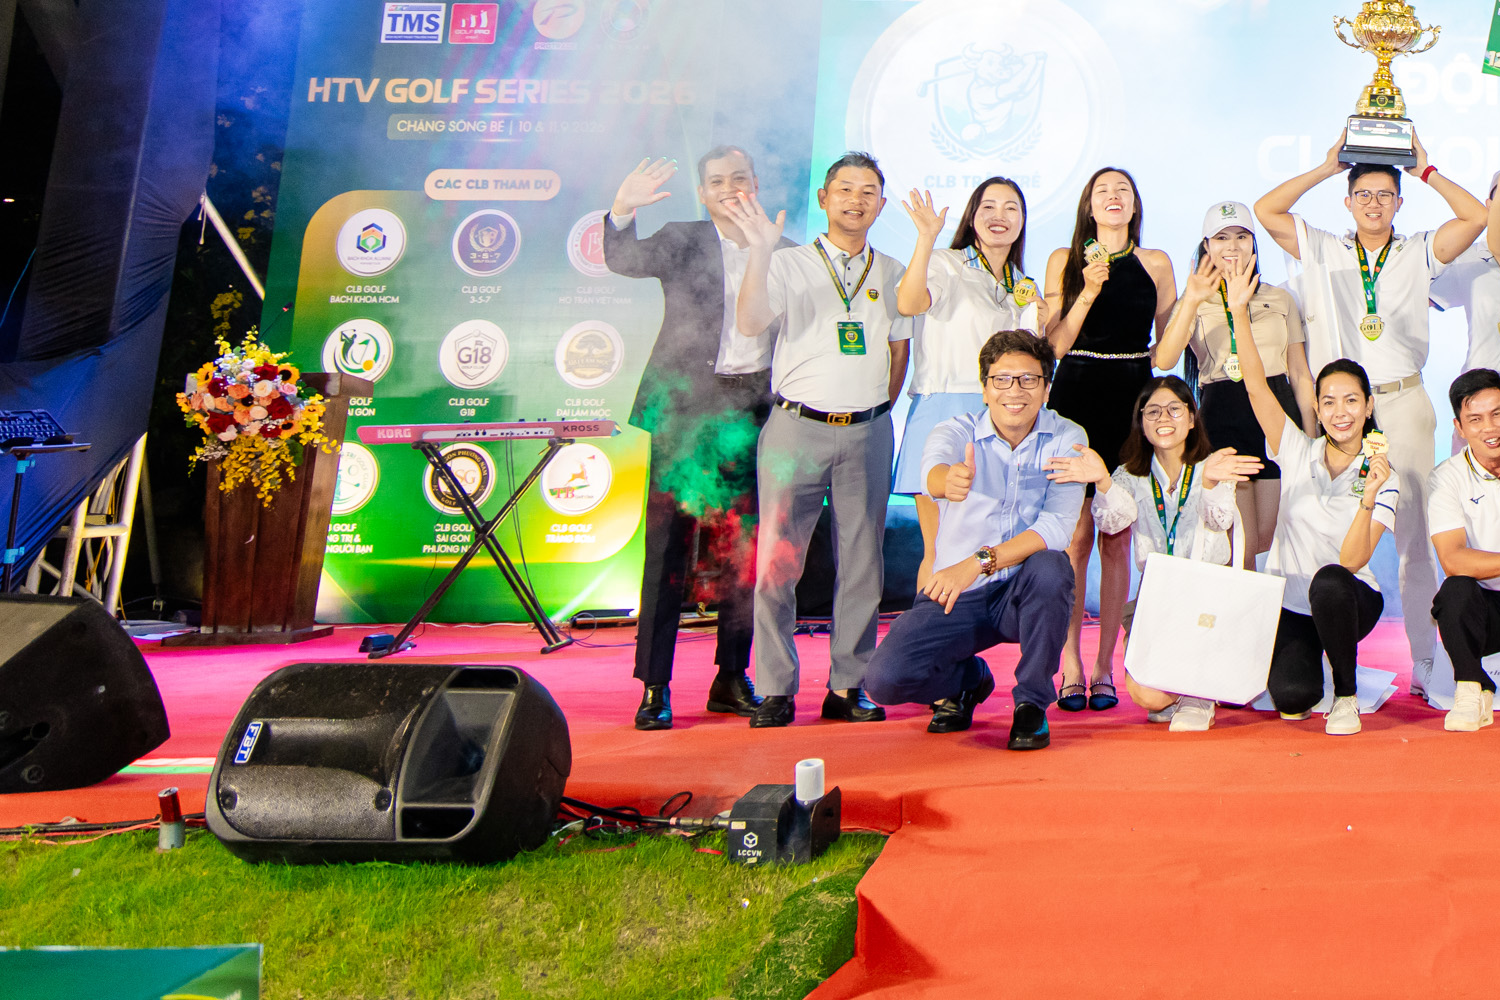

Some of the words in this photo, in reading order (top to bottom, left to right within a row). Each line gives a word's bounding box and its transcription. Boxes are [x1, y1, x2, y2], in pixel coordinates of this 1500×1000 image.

[387, 13, 440, 32] TMS
[307, 77, 381, 103] HTV
[385, 78, 470, 104] GOLF
[474, 78, 590, 104] SERIES
[602, 79, 697, 105] 2026
[448, 119, 487, 132] SÔNG
[518, 121, 531, 132] 10
[466, 179, 489, 189] CLB
[493, 179, 530, 189] THAM
[924, 175, 957, 188] CLB
[345, 285, 362, 293] CLB
[363, 285, 387, 293] GOLF
[461, 286, 477, 294] CLB
[479, 286, 502, 294] GOLF
[353, 295, 378, 303] KHOA
[379, 295, 400, 303] HCM
[457, 347, 492, 364] G18
[349, 397, 373, 406] GOLF
[448, 398, 465, 406] CLB
[466, 398, 489, 406] GOLF
[565, 398, 580, 407] CLB
[581, 398, 605, 407] GOLF
[460, 408, 476, 416] G18
[562, 424, 600, 432] KROSS
[377, 428, 411, 438] KORG
[552, 487, 575, 499] TB
[333, 523, 357, 532] GOLF
[434, 523, 450, 532] CLB
[451, 523, 475, 532] GOLF
[569, 524, 592, 532] GOLF
[354, 534, 361, 543] &
[239, 724, 260, 759] FBT
[737, 849, 762, 857] LCCVN
